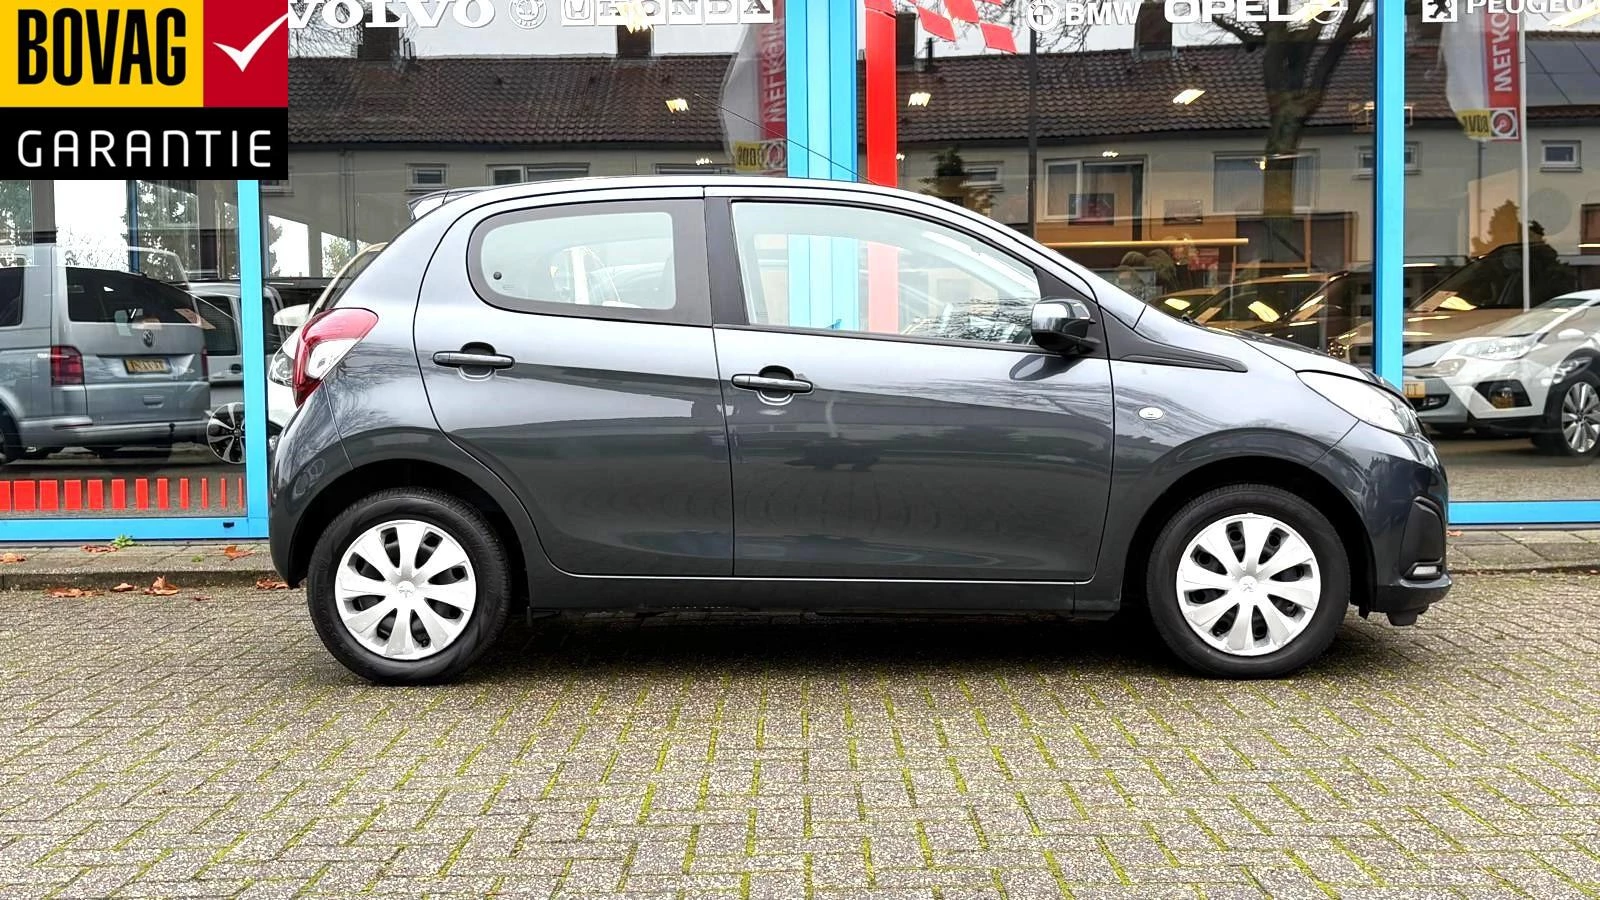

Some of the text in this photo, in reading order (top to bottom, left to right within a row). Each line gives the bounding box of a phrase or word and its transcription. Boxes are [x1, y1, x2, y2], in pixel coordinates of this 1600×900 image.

[288, 0, 496, 28] VOLVO
[1065, 0, 1139, 25] BMW
[1164, 0, 1296, 23] OPEL
[1466, 0, 1600, 14] PEUGEO
